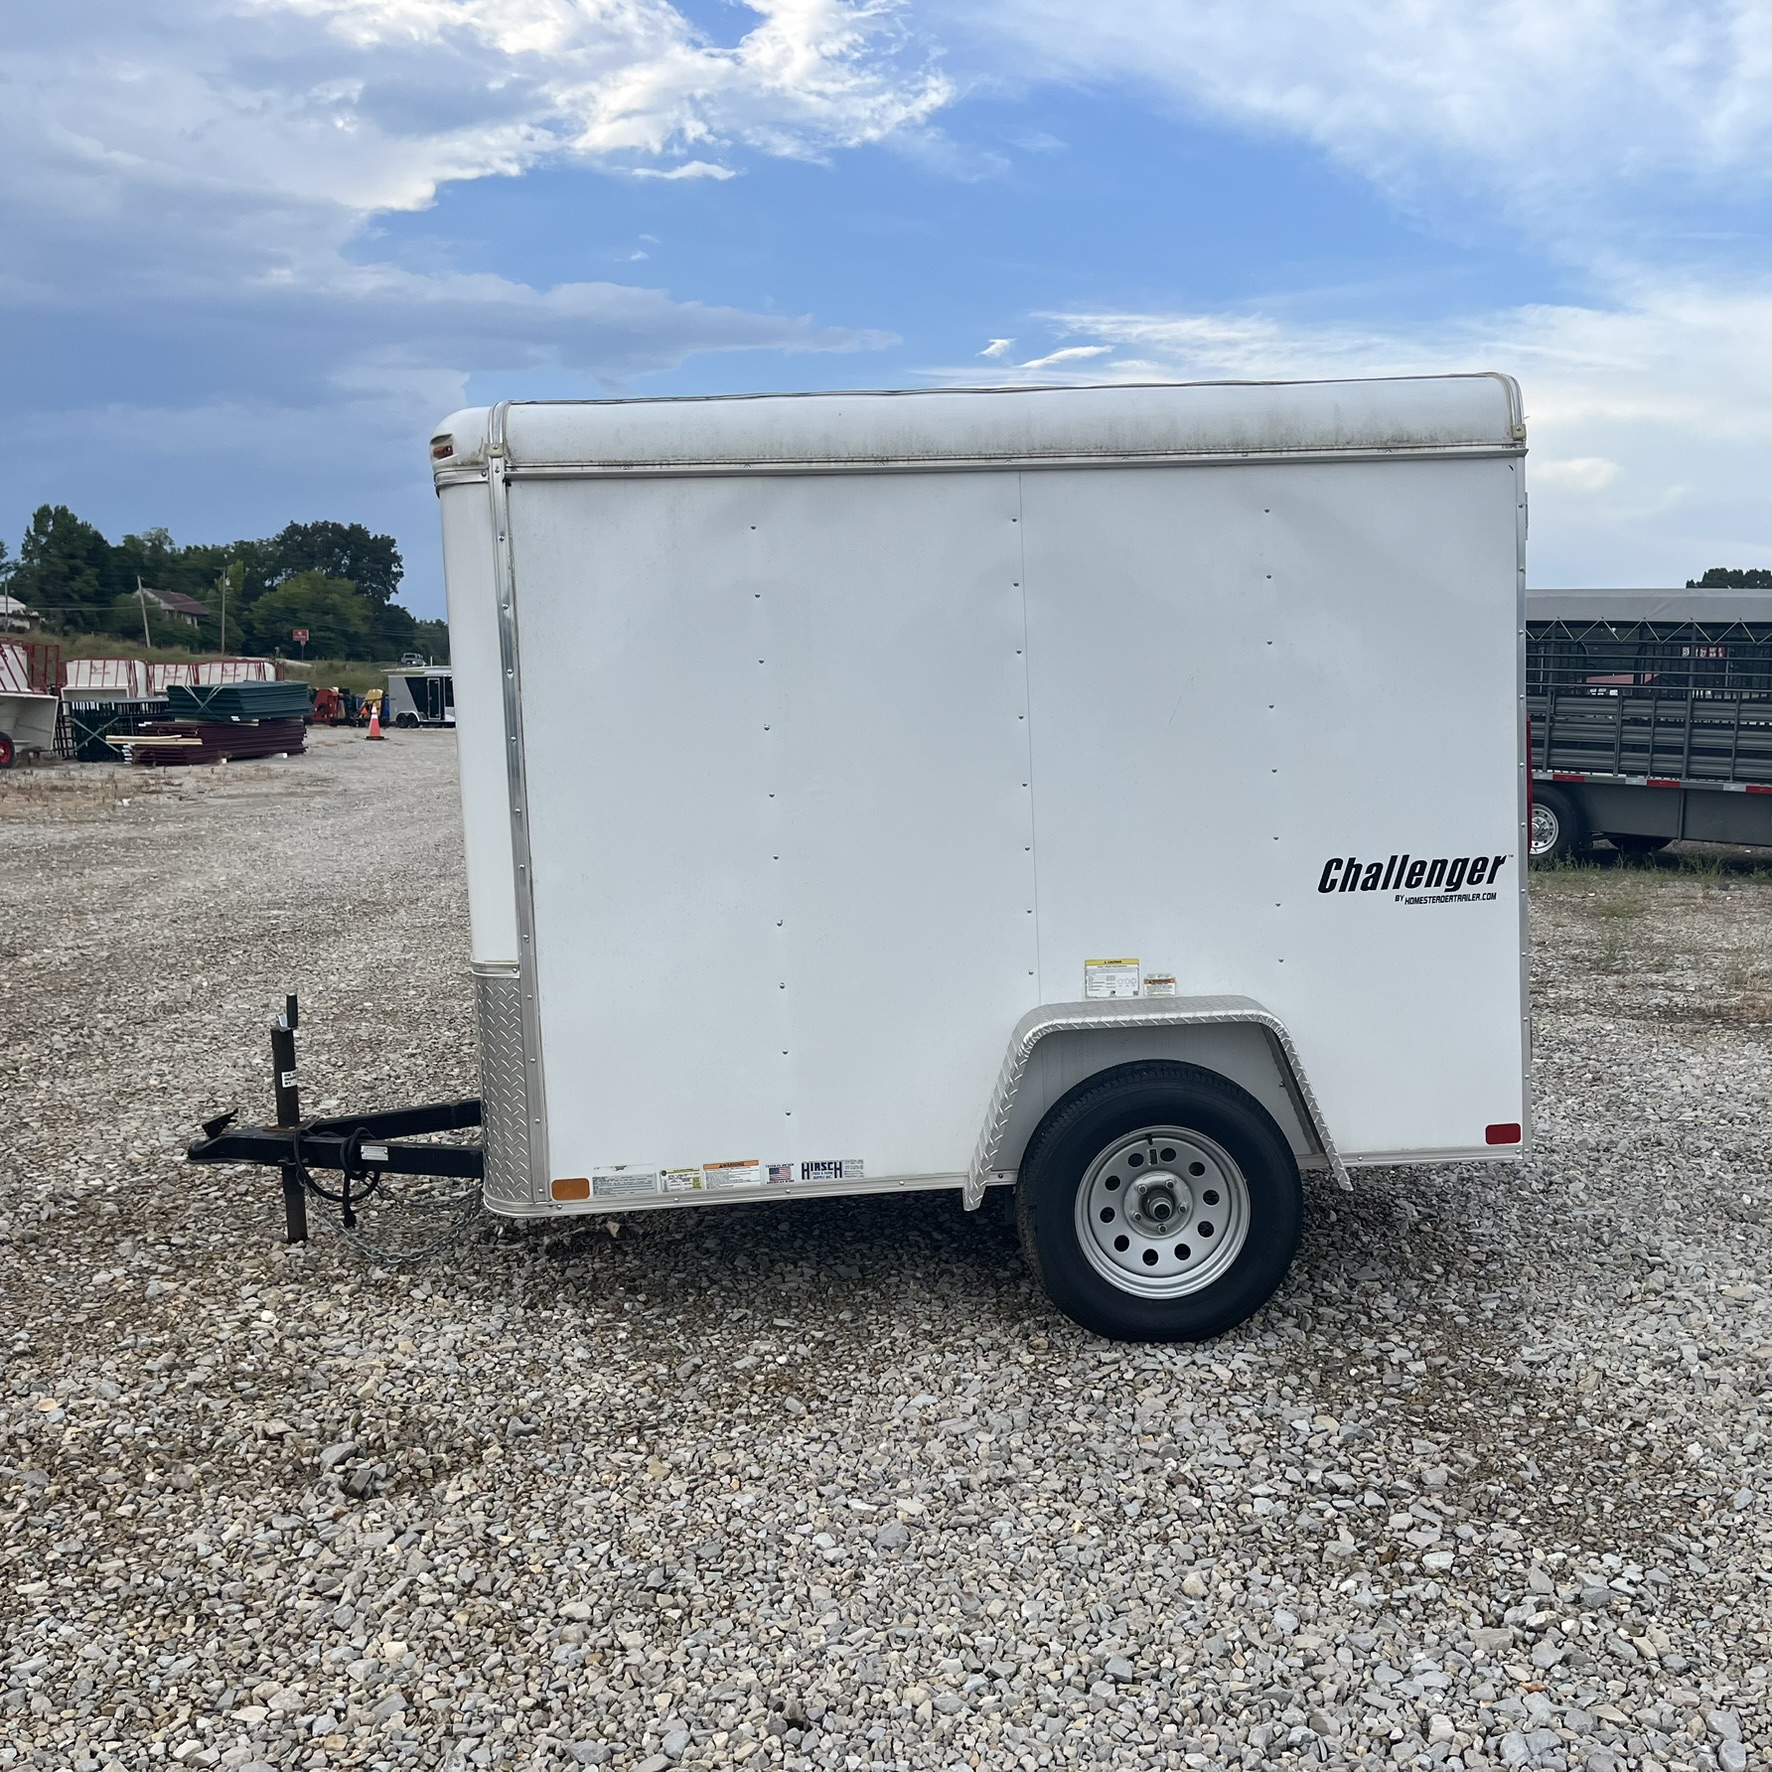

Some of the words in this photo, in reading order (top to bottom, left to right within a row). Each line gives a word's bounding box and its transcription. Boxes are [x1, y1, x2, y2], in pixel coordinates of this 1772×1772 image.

[1317, 854, 1507, 893] Challenger
[1394, 894, 1405, 902] BY
[1404, 892, 1497, 905] HOMESTEADERTRAILER.COM
[801, 1161, 843, 1180] HIRSCH
